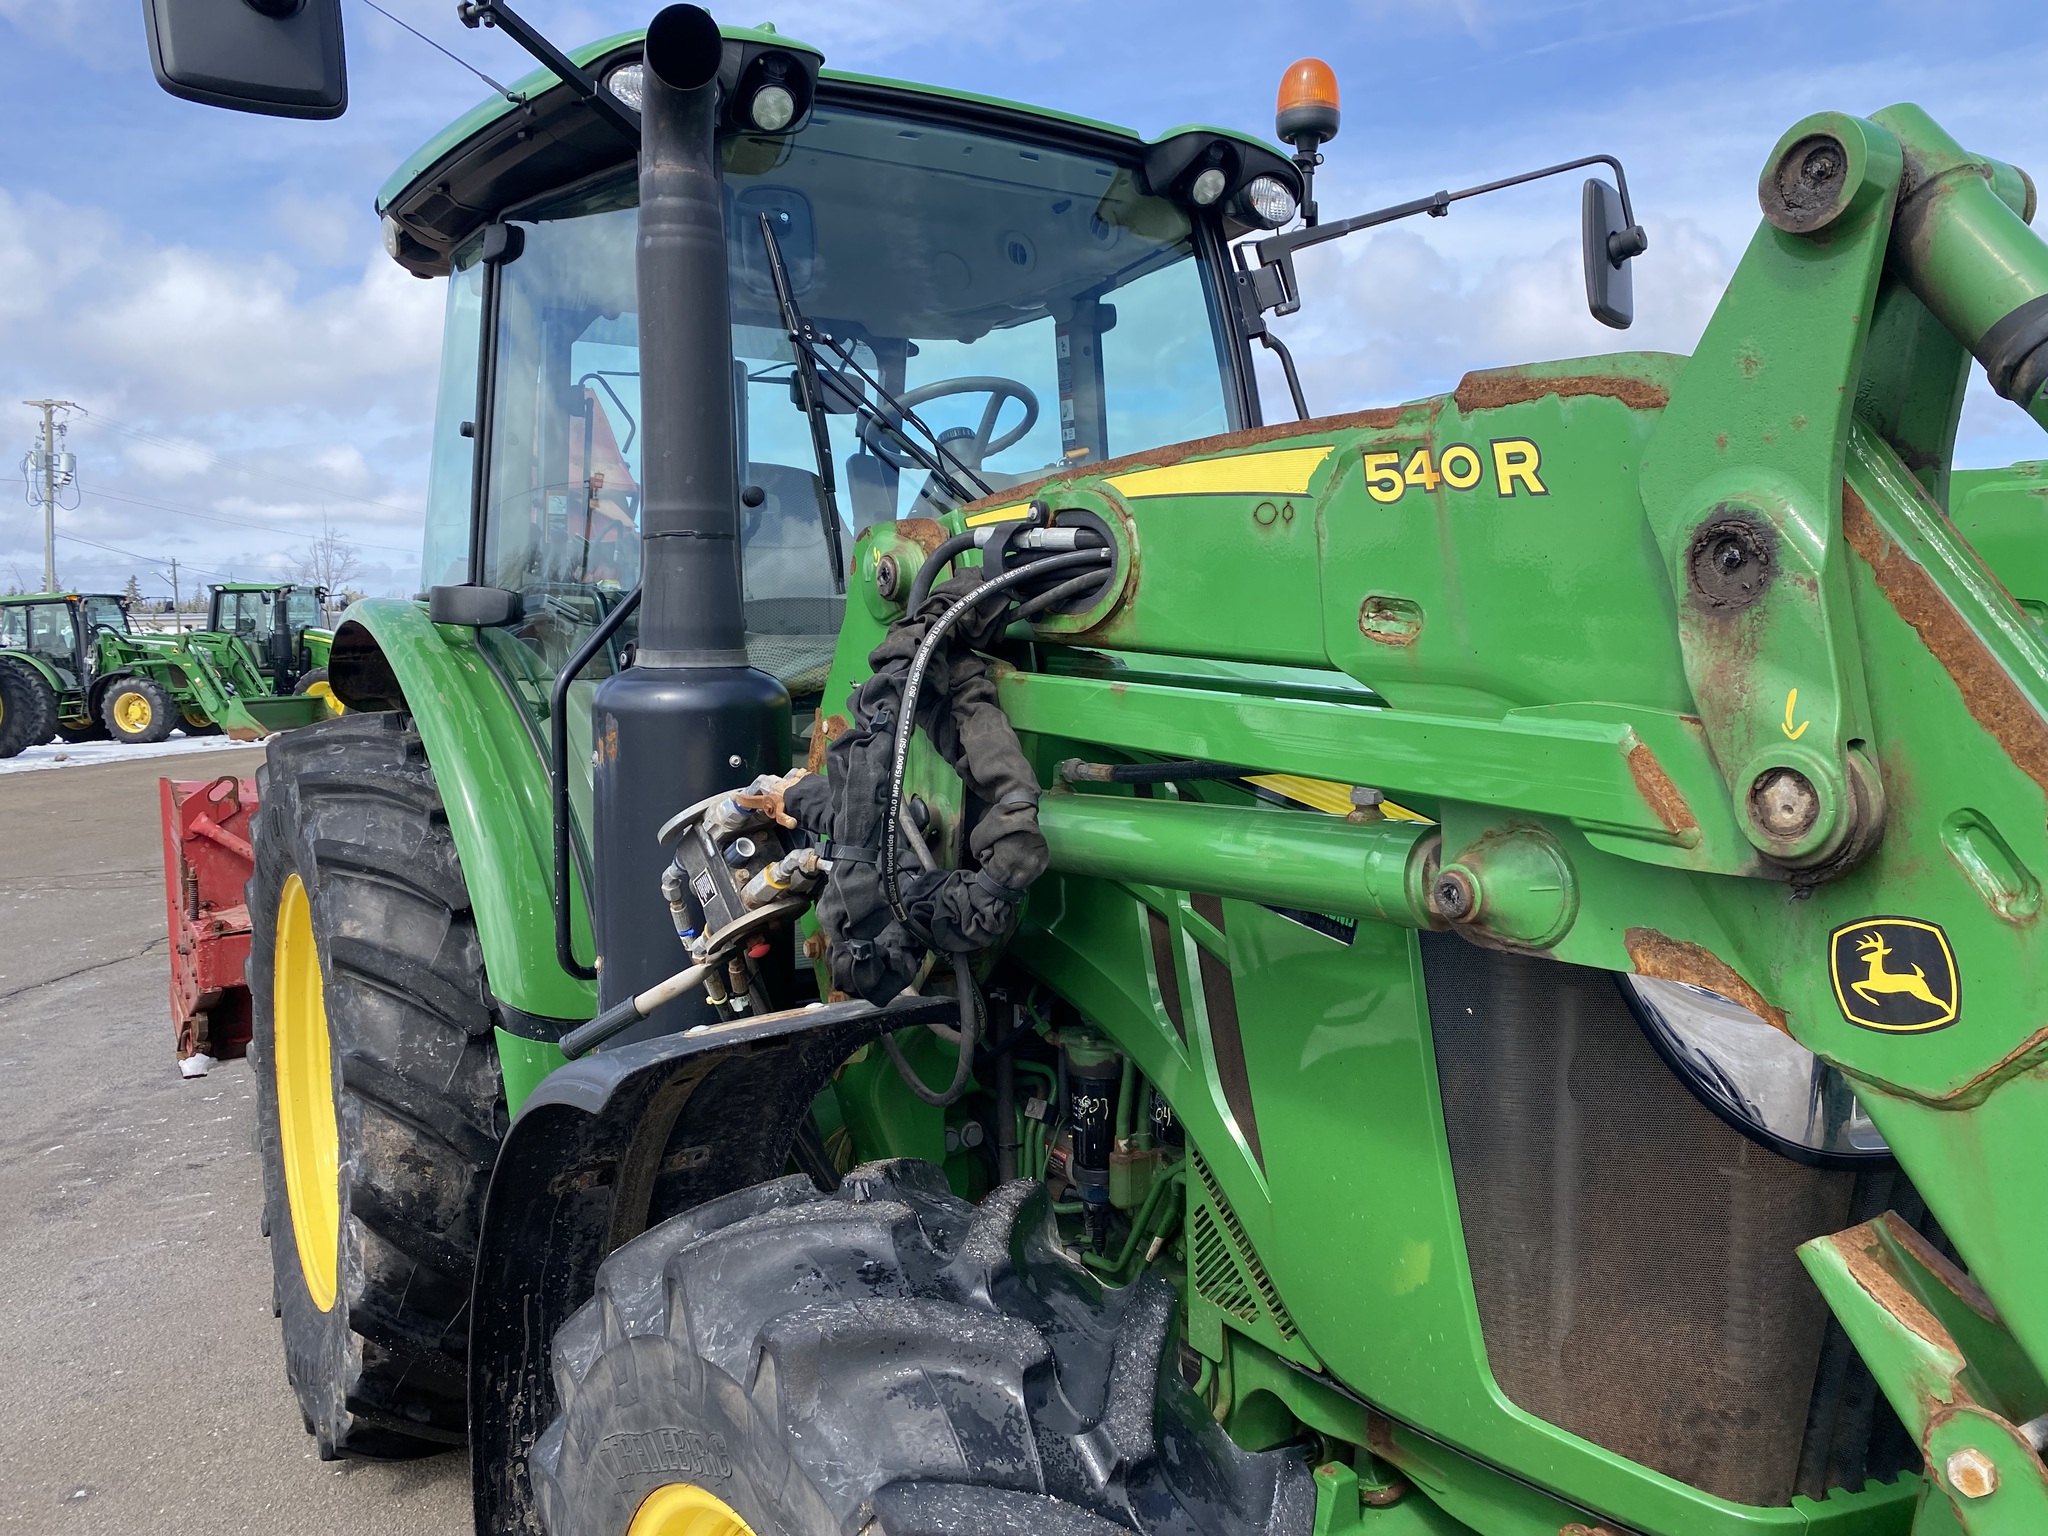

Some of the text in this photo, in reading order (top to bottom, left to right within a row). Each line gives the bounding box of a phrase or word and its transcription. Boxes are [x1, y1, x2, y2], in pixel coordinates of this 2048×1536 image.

[1363, 436, 1552, 505] 540 R
[995, 575, 1006, 585] IN
[1003, 564, 1033, 581] MEXICO
[977, 580, 998, 594] MADE
[908, 685, 917, 698] ISO
[898, 737, 908, 756] PSI)
[894, 755, 905, 778] (5800
[891, 779, 901, 798] MPa
[889, 799, 898, 817] 40,0
[887, 818, 896, 833] WP
[886, 834, 895, 875] Worldwide
